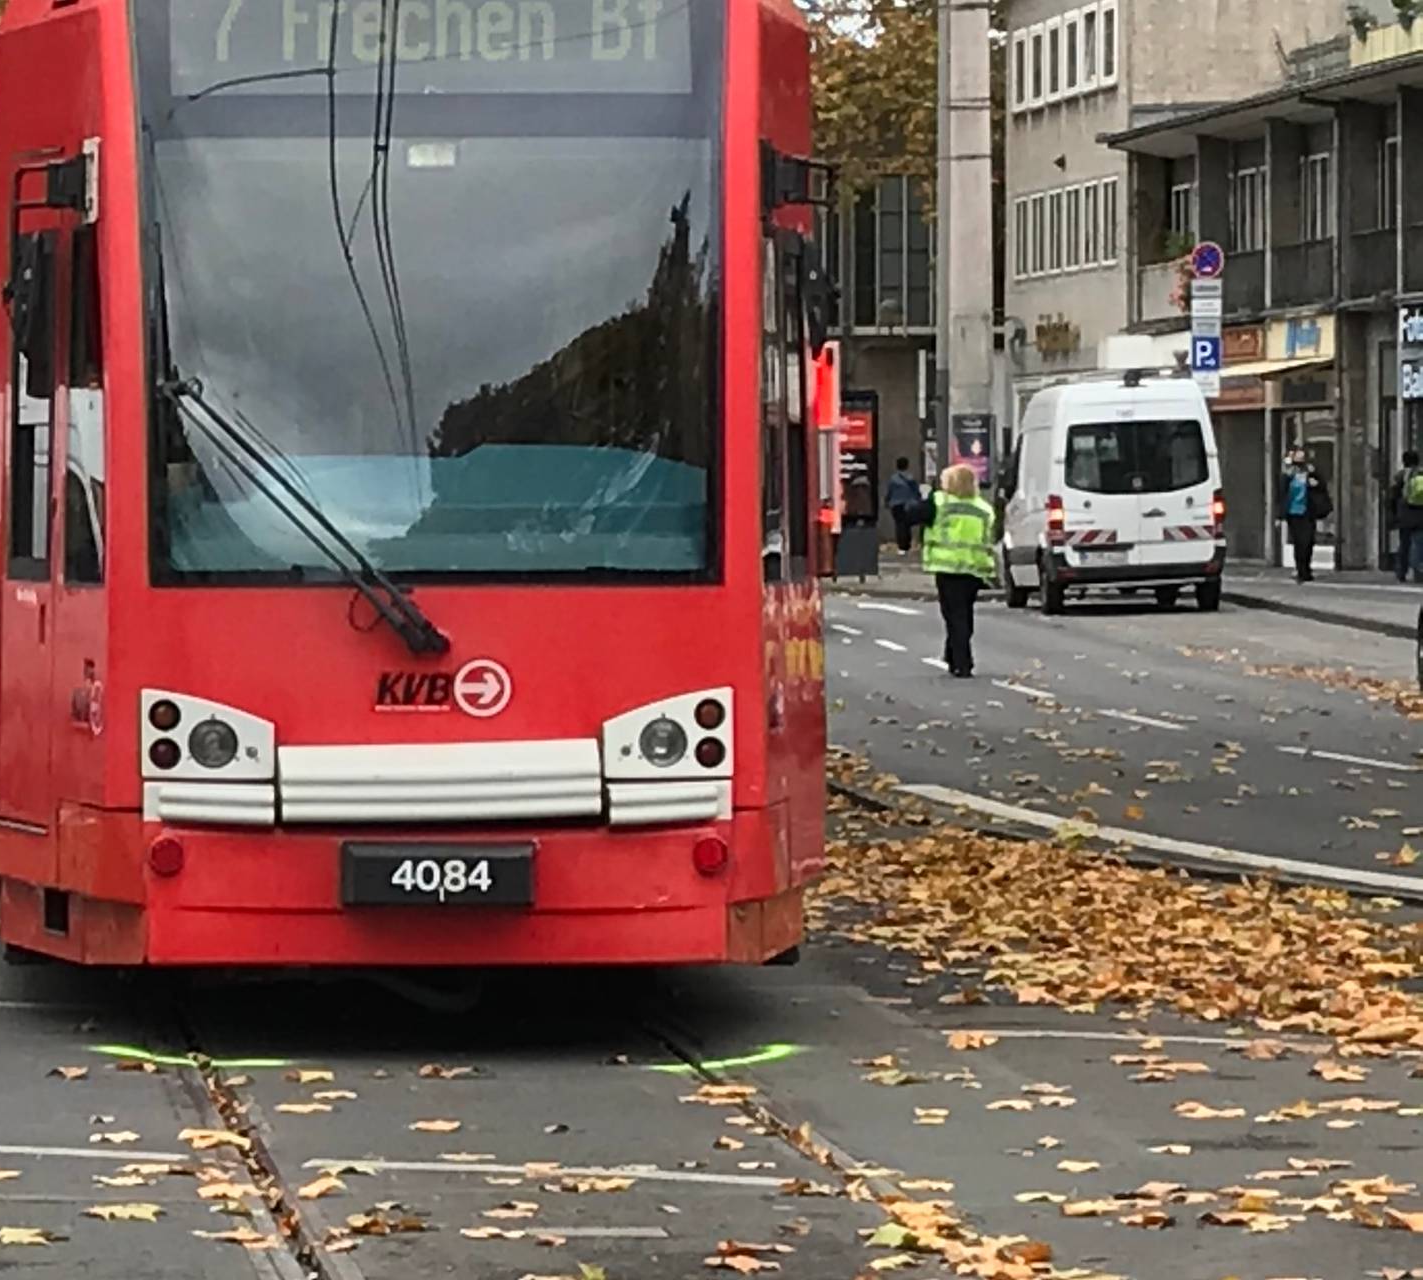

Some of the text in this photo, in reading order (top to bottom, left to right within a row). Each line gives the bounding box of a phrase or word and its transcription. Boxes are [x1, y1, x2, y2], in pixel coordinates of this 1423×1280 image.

[283, 0, 555, 62] Frechen
[1196, 340, 1213, 367] P
[376, 671, 453, 706] KVB
[391, 859, 492, 893] 4084
